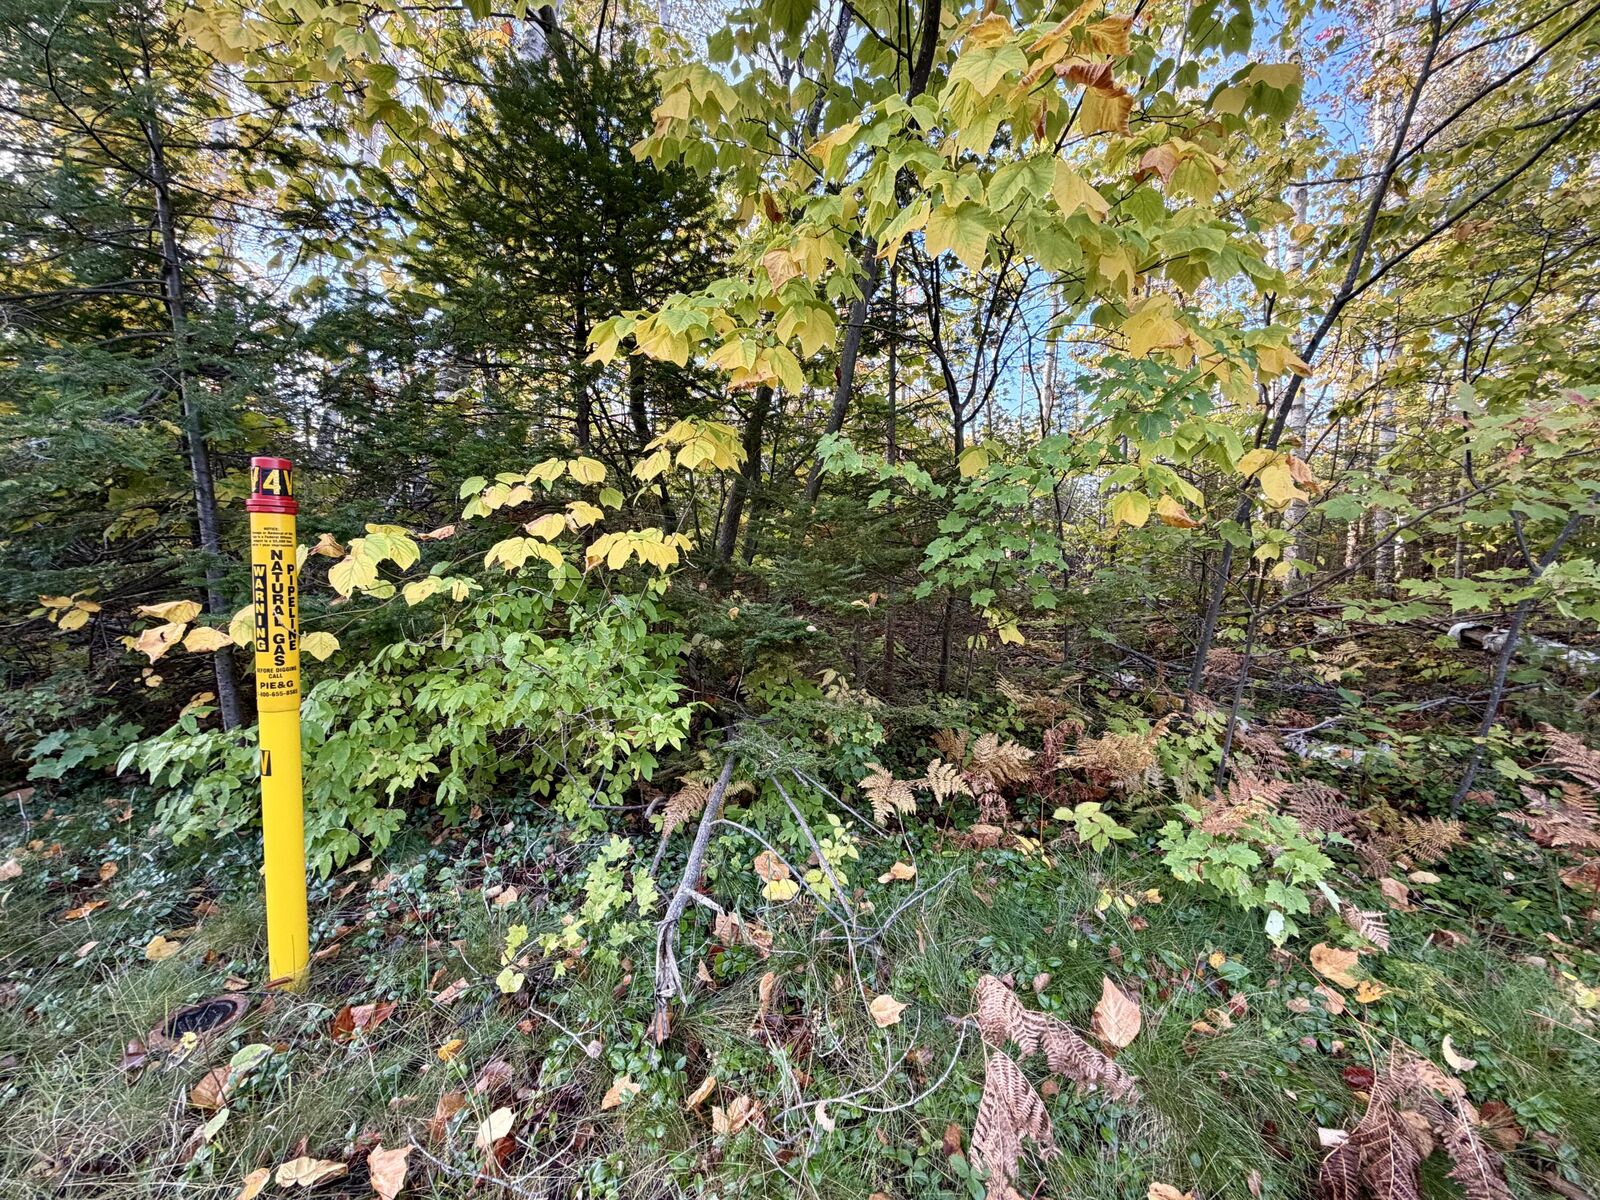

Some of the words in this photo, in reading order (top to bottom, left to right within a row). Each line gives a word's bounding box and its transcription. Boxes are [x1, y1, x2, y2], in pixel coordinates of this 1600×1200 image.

[254, 565, 267, 650] WARNING
[271, 550, 284, 626] NATURAL
[287, 564, 297, 650] PIPELINE
[260, 680, 294, 689] PIE&G
[273, 634, 285, 666] GAS
